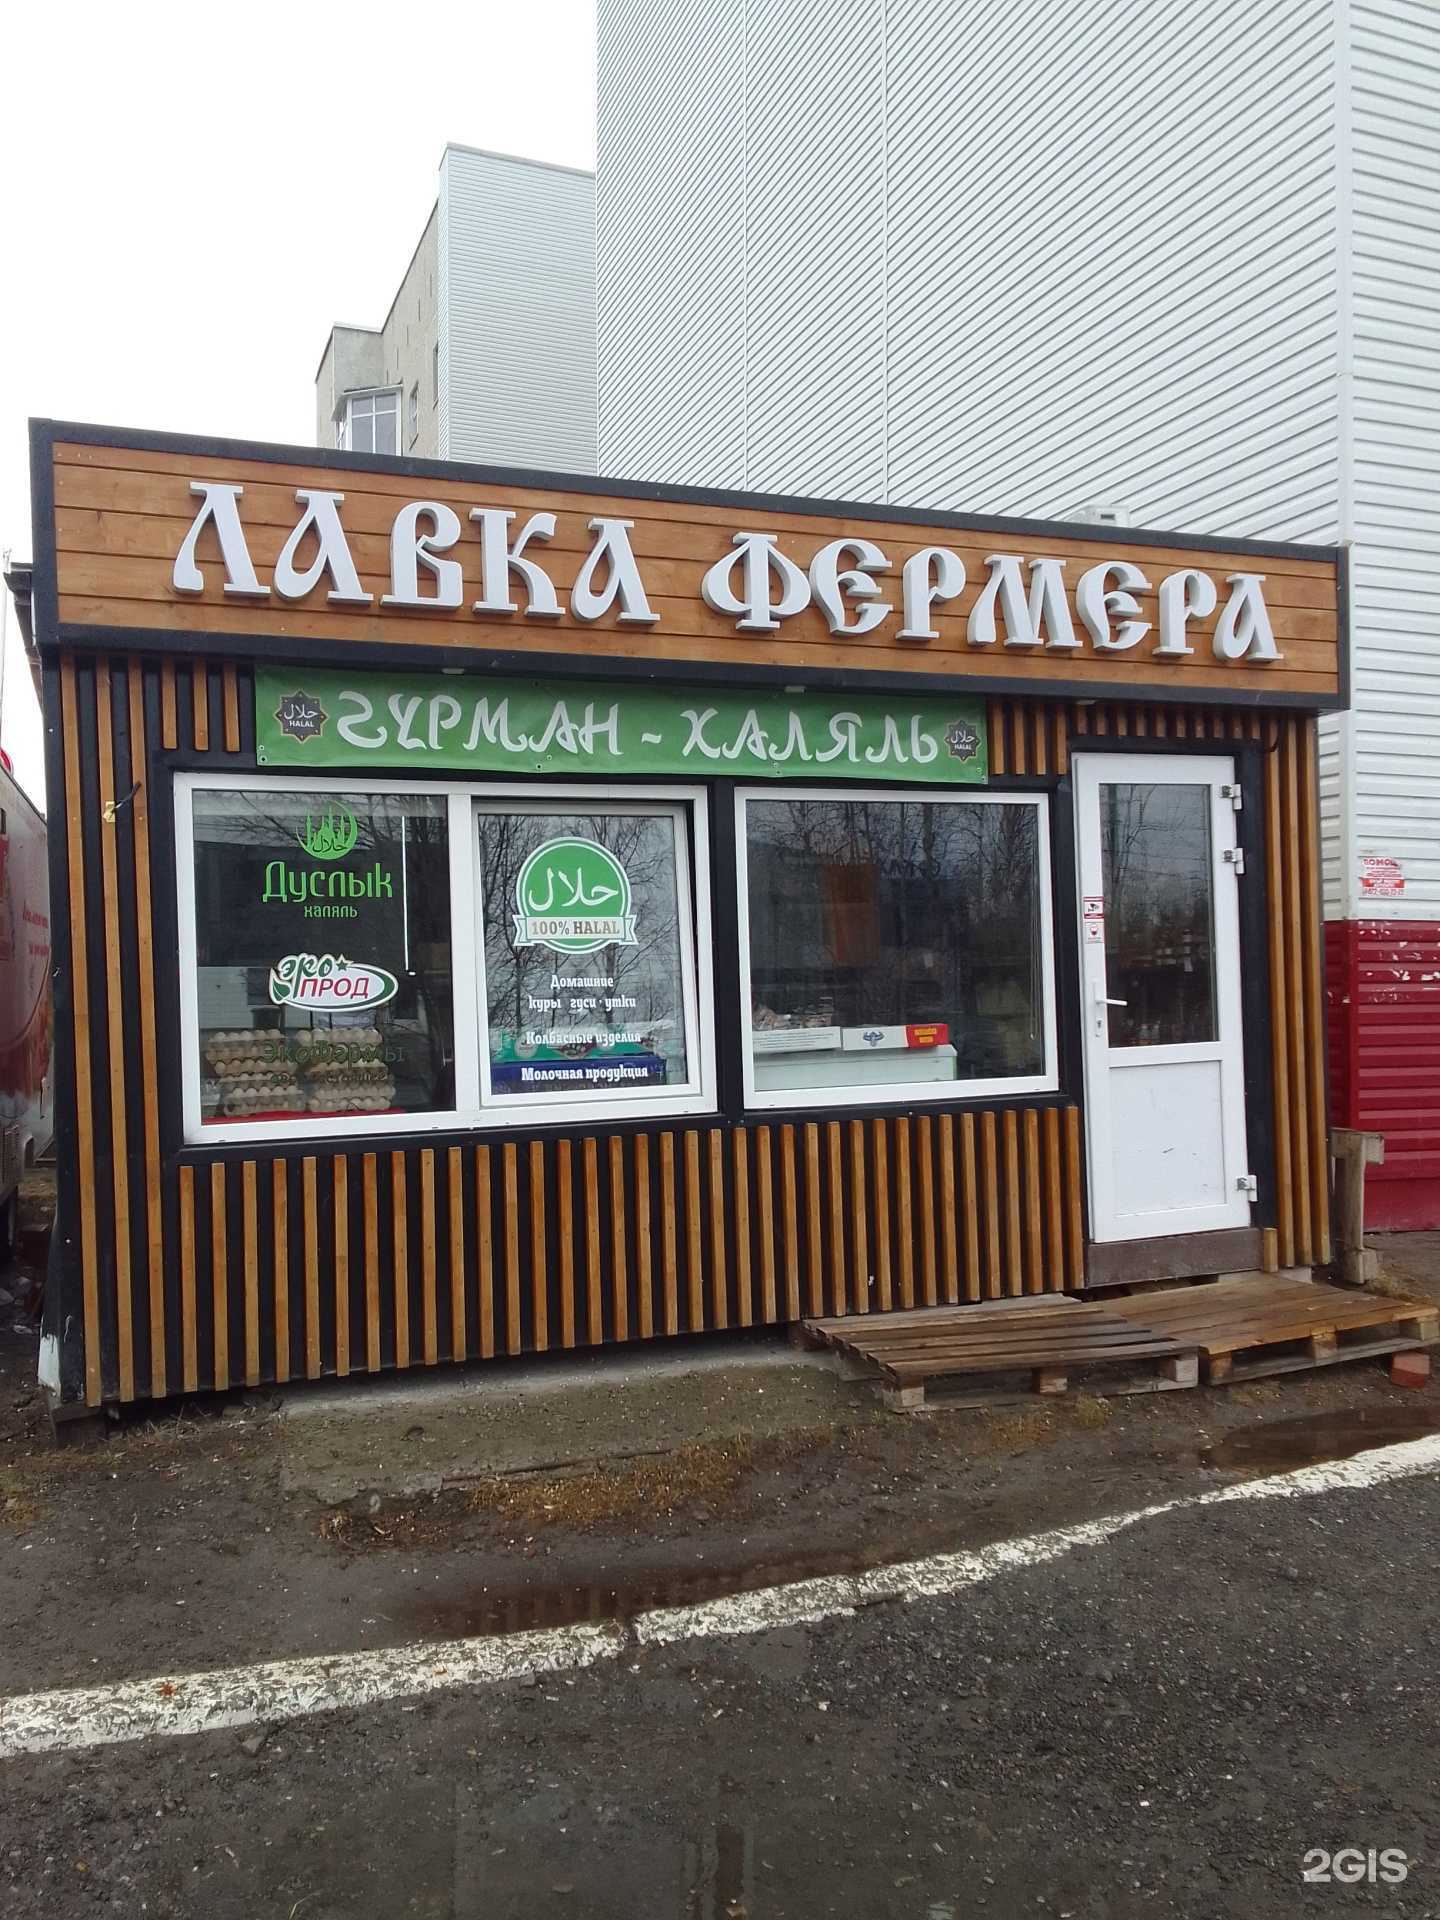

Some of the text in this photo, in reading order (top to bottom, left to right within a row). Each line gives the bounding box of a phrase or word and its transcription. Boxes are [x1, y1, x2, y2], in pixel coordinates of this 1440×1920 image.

[172, 482, 1285, 662] ЛАВКА ФЕРМЕРА
[284, 703, 319, 720] حلال
[289, 720, 315, 728] HALAL
[337, 690, 624, 755] ГУРМАН
[680, 708, 939, 763] ХАЛЯЛЬ
[262, 861, 393, 903] Дуслык
[528, 867, 619, 911] حلال
[303, 905, 359, 918] халяль
[531, 920, 620, 936] 100% HALAL
[300, 978, 370, 999] ПРОД
[550, 974, 614, 990] Домашние
[528, 995, 636, 1012] куры гуси утки
[526, 1031, 641, 1047] Колбасные изделия
[521, 1064, 649, 1082] Молочная продукция
